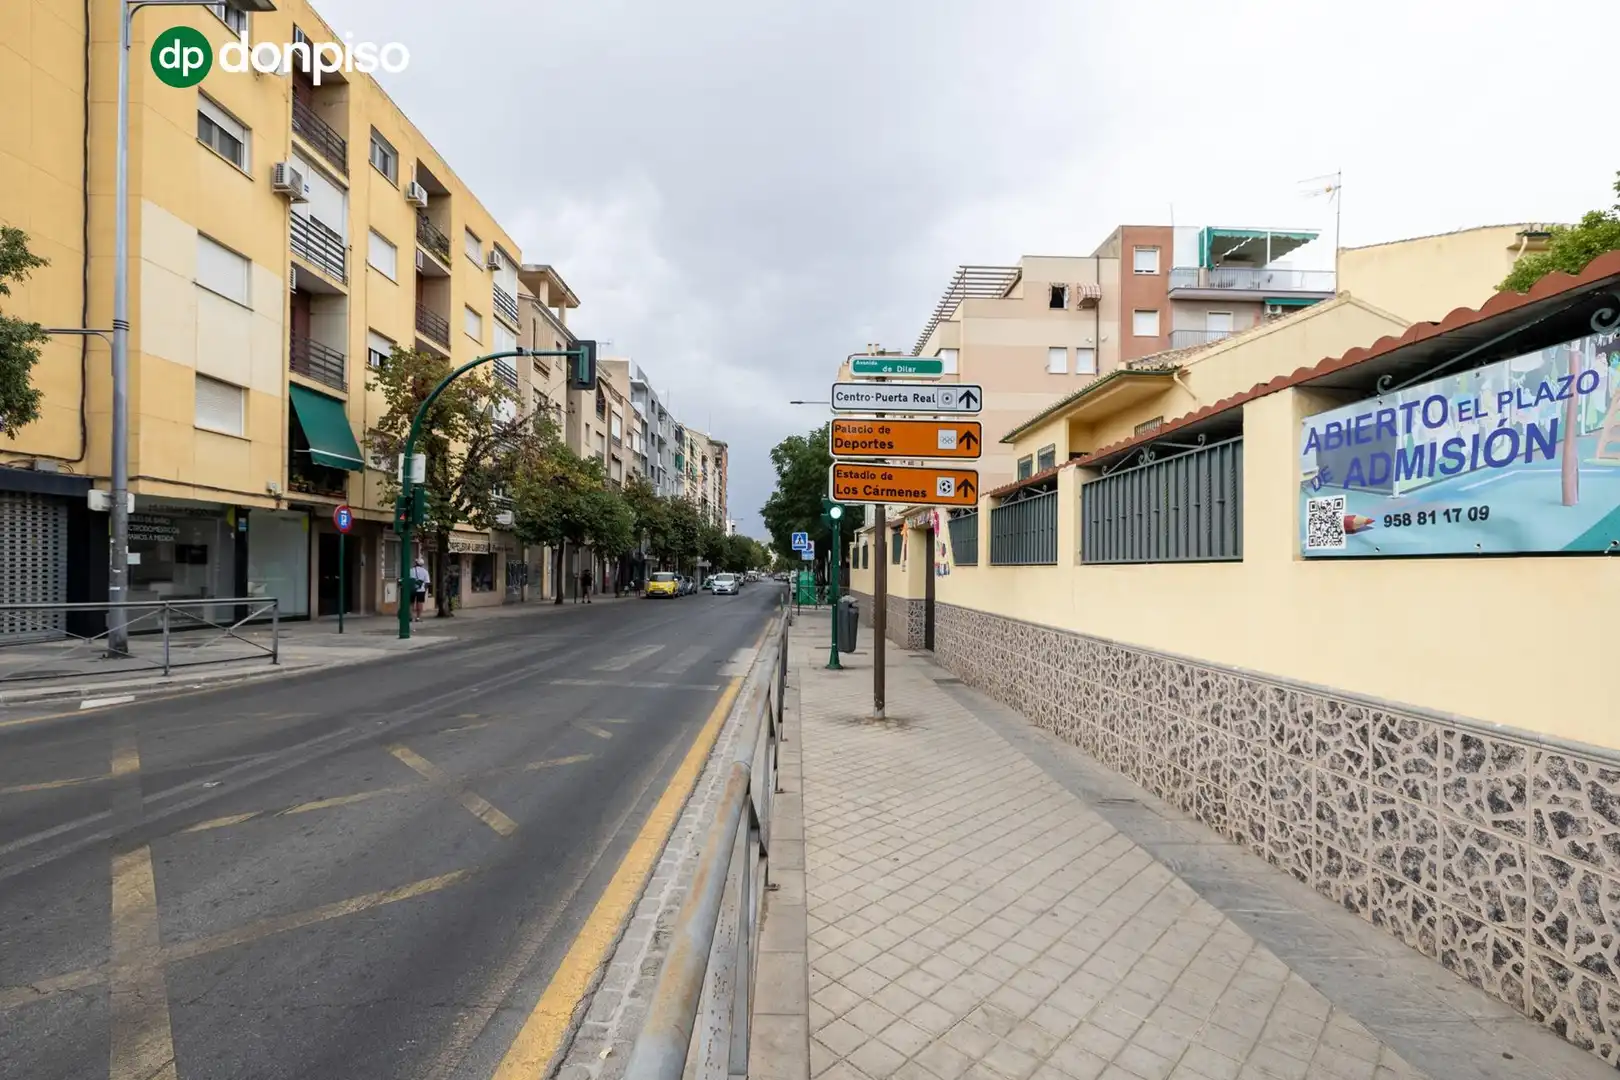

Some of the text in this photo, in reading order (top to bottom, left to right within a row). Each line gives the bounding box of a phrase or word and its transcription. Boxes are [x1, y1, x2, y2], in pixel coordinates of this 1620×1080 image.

[882, 365, 893, 373] de
[836, 391, 936, 404] Centro-Puerta Real
[1303, 369, 1600, 456] ABIERTO EL PLAZO
[834, 424, 891, 434] Palacio de
[834, 438, 894, 450] Deportes
[1310, 418, 1558, 492] DE ADMISIÓN
[836, 470, 893, 481] Estadio de
[836, 484, 928, 499] Los Cármenes
[1383, 505, 1490, 528] 958 81 17 09
